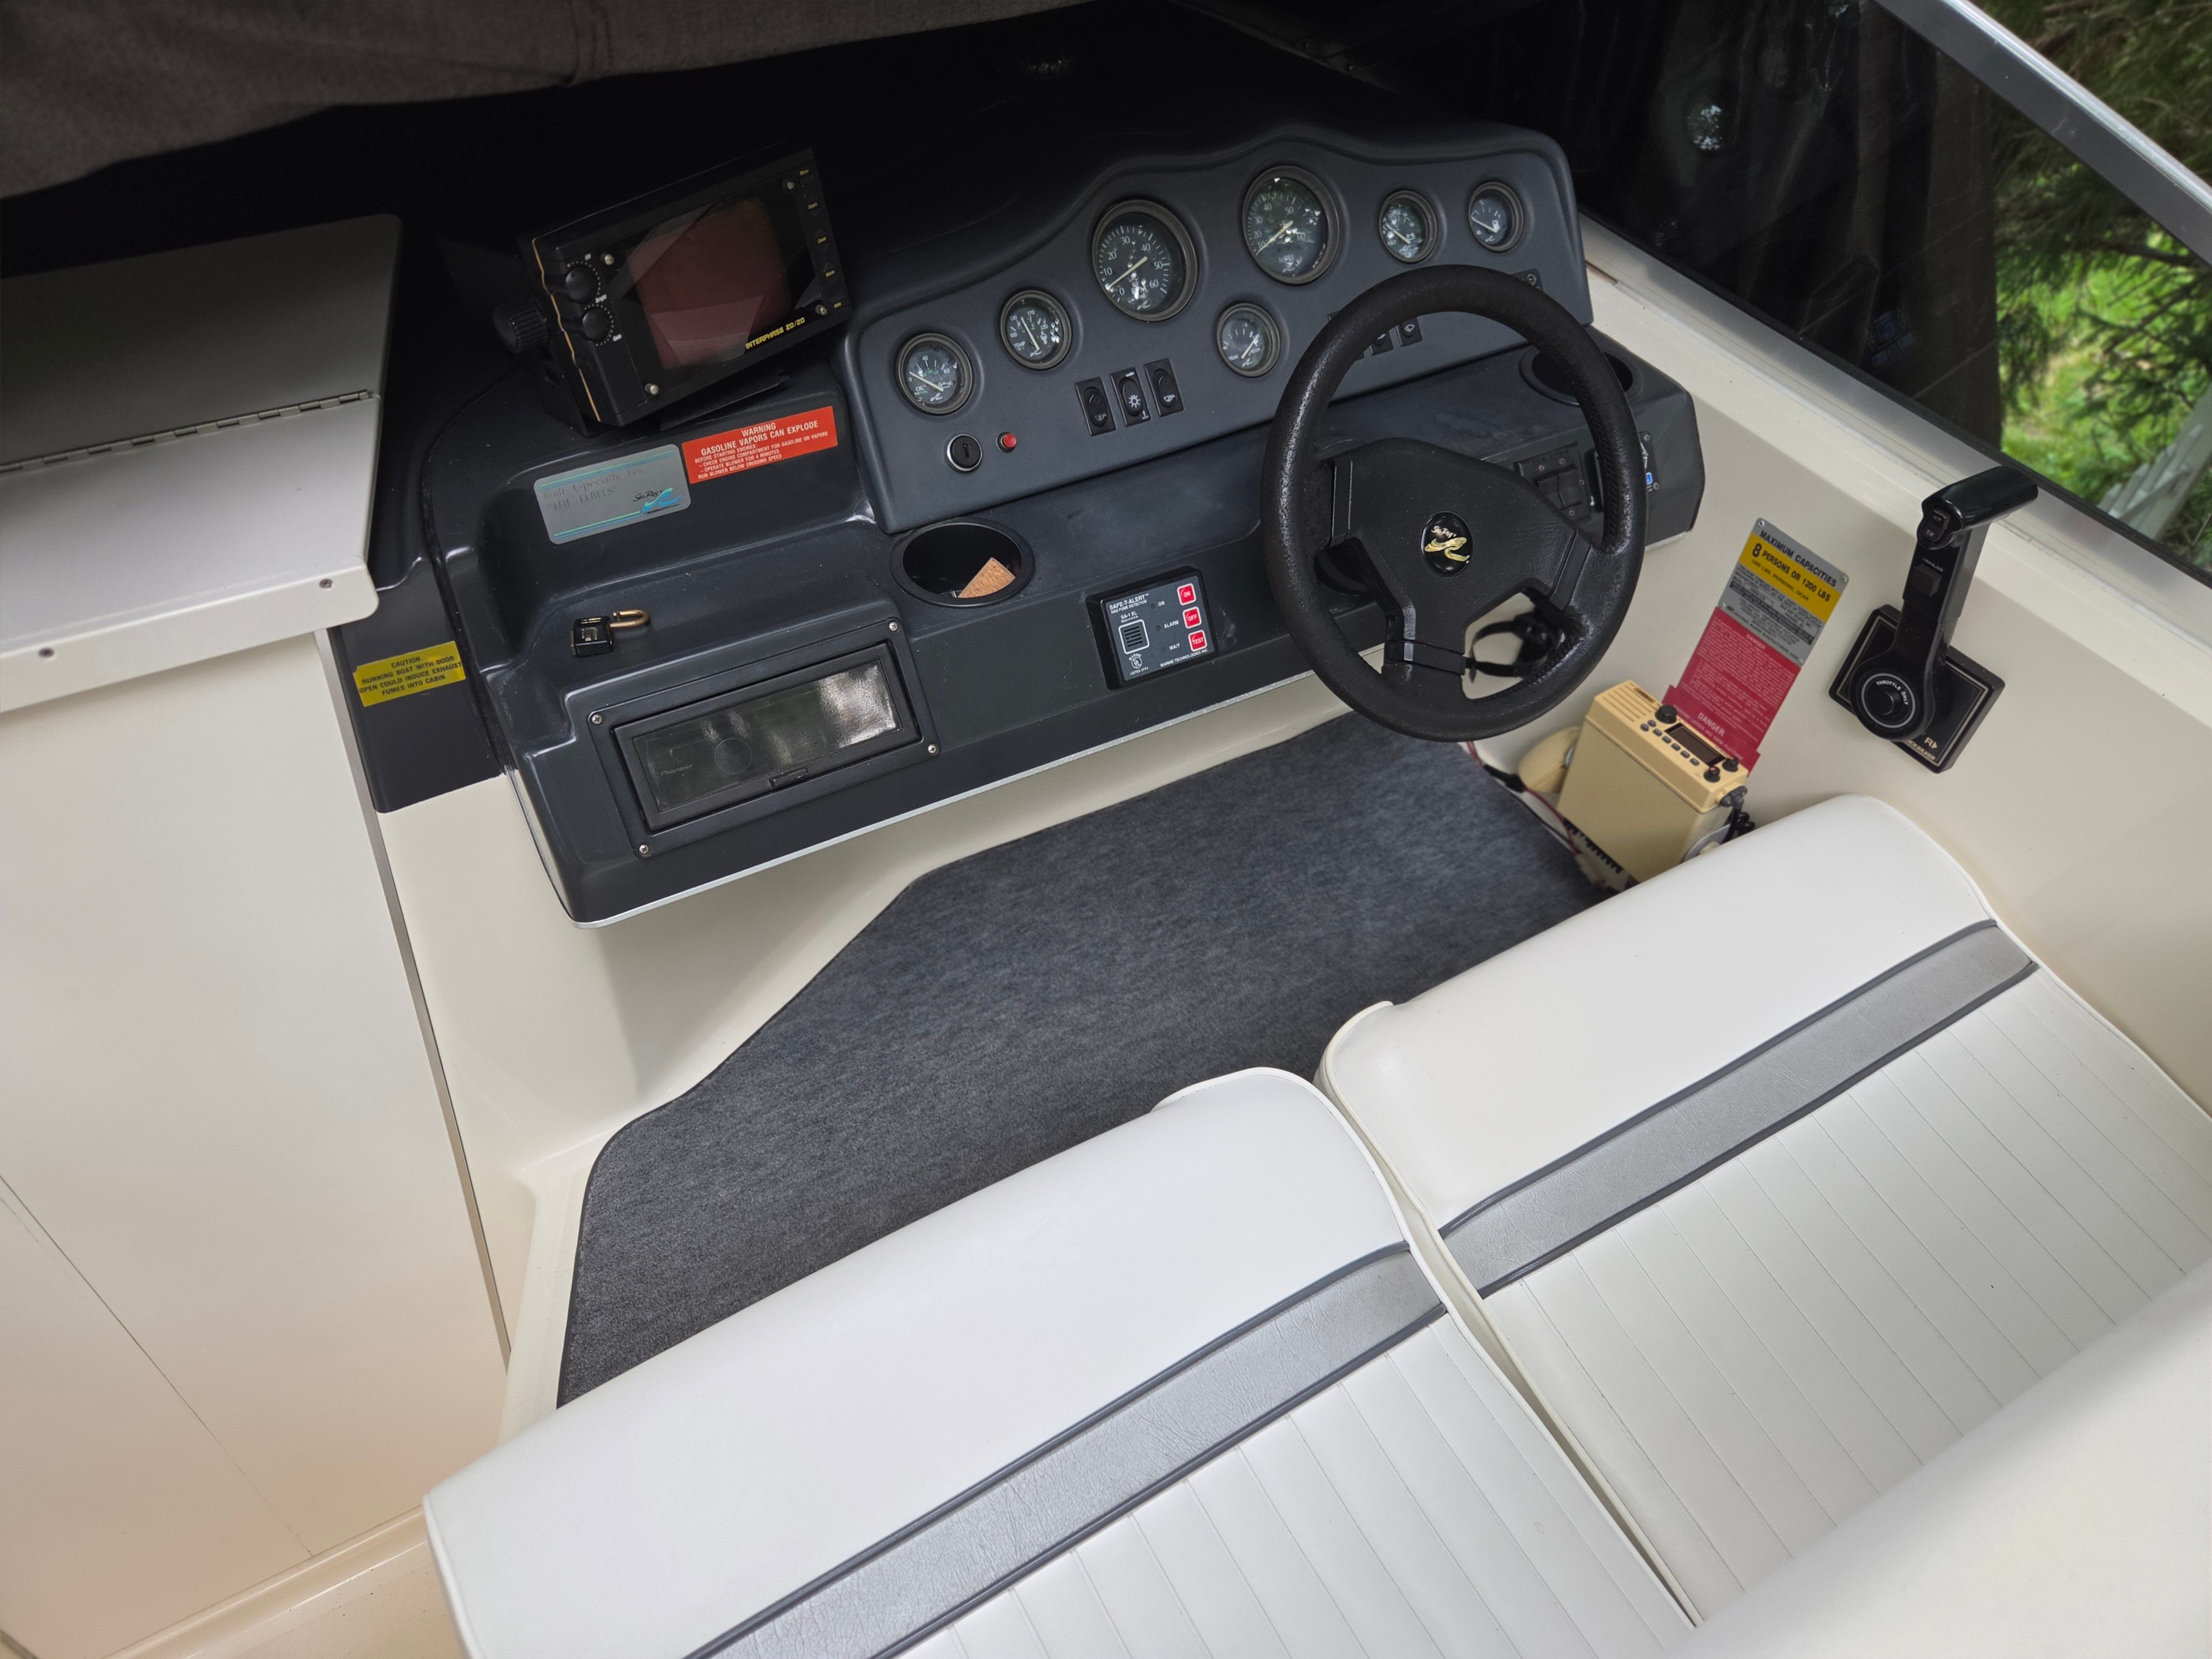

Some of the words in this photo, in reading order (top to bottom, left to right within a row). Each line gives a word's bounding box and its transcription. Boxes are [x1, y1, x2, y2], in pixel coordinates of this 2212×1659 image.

[1263, 203, 1272, 211] 40
[1285, 206, 1294, 215] 50
[1254, 216, 1263, 225] 30
[1120, 236, 1130, 245] 30
[1254, 230, 1262, 239] 20
[1141, 243, 1151, 252] 40
[1107, 251, 1117, 260] 20
[1103, 267, 1113, 276] 10
[1154, 261, 1163, 270] 50
[1149, 279, 1159, 289] 60
[1119, 287, 1125, 295] 0
[745, 326, 784, 349] INTERPHASE
[785, 317, 805, 331] 20/20
[741, 422, 776, 437] WARNING
[701, 441, 737, 456] GASOLINE
[739, 433, 768, 446] VAPORS
[770, 429, 785, 439] CAN
[787, 420, 818, 434] EXPLODE
[719, 455, 735, 463] ENGINE
[737, 446, 770, 458] COMPARTMENT
[781, 437, 802, 447] GASOLINE
[811, 431, 828, 440] VAPORS
[695, 455, 712, 463] BEFORE
[713, 449, 735, 458] STARTING
[704, 463, 724, 472] OPERATE
[726, 458, 744, 467] BLOWER
[760, 448, 780, 458] MINUTES
[709, 468, 728, 477] BLOWER
[746, 458, 767, 467] CRUISING
[768, 453, 782, 462] SPEED
[1760, 530, 1794, 558] MAXIMUM
[1795, 555, 1837, 587] CAPACITIES
[1923, 557, 1943, 572] TRAILER
[1752, 543, 1762, 558] 8
[1762, 550, 1790, 573] PERSONS
[1791, 571, 1801, 581] OR
[1803, 578, 1817, 592] 1200
[1817, 588, 1831, 602] LBS
[1796, 589, 1809, 601] GEAR
[1129, 599, 1147, 608] DETECTOR
[1164, 620, 1178, 628] ALARM
[1746, 634, 1765, 650] DANGER
[392, 656, 420, 668] CAUTION
[1175, 651, 1201, 662] TECHNOLOGIES
[362, 672, 393, 684] RUNNING
[396, 666, 413, 675] BOAT
[416, 661, 434, 670] WITH
[436, 656, 455, 665] DOOR
[359, 685, 377, 693] OPEN
[380, 677, 402, 688] COULD
[405, 671, 430, 681] INDUCE
[432, 662, 462, 674] EXHAUST
[382, 685, 405, 696] FUMES
[408, 680, 423, 688] INTO
[425, 675, 445, 684] CABIN
[1876, 680, 1902, 691] THROTTLE
[1698, 712, 1725, 737] DANGER
[1924, 737, 1933, 746] R
[661, 764, 693, 777] Pioneer
